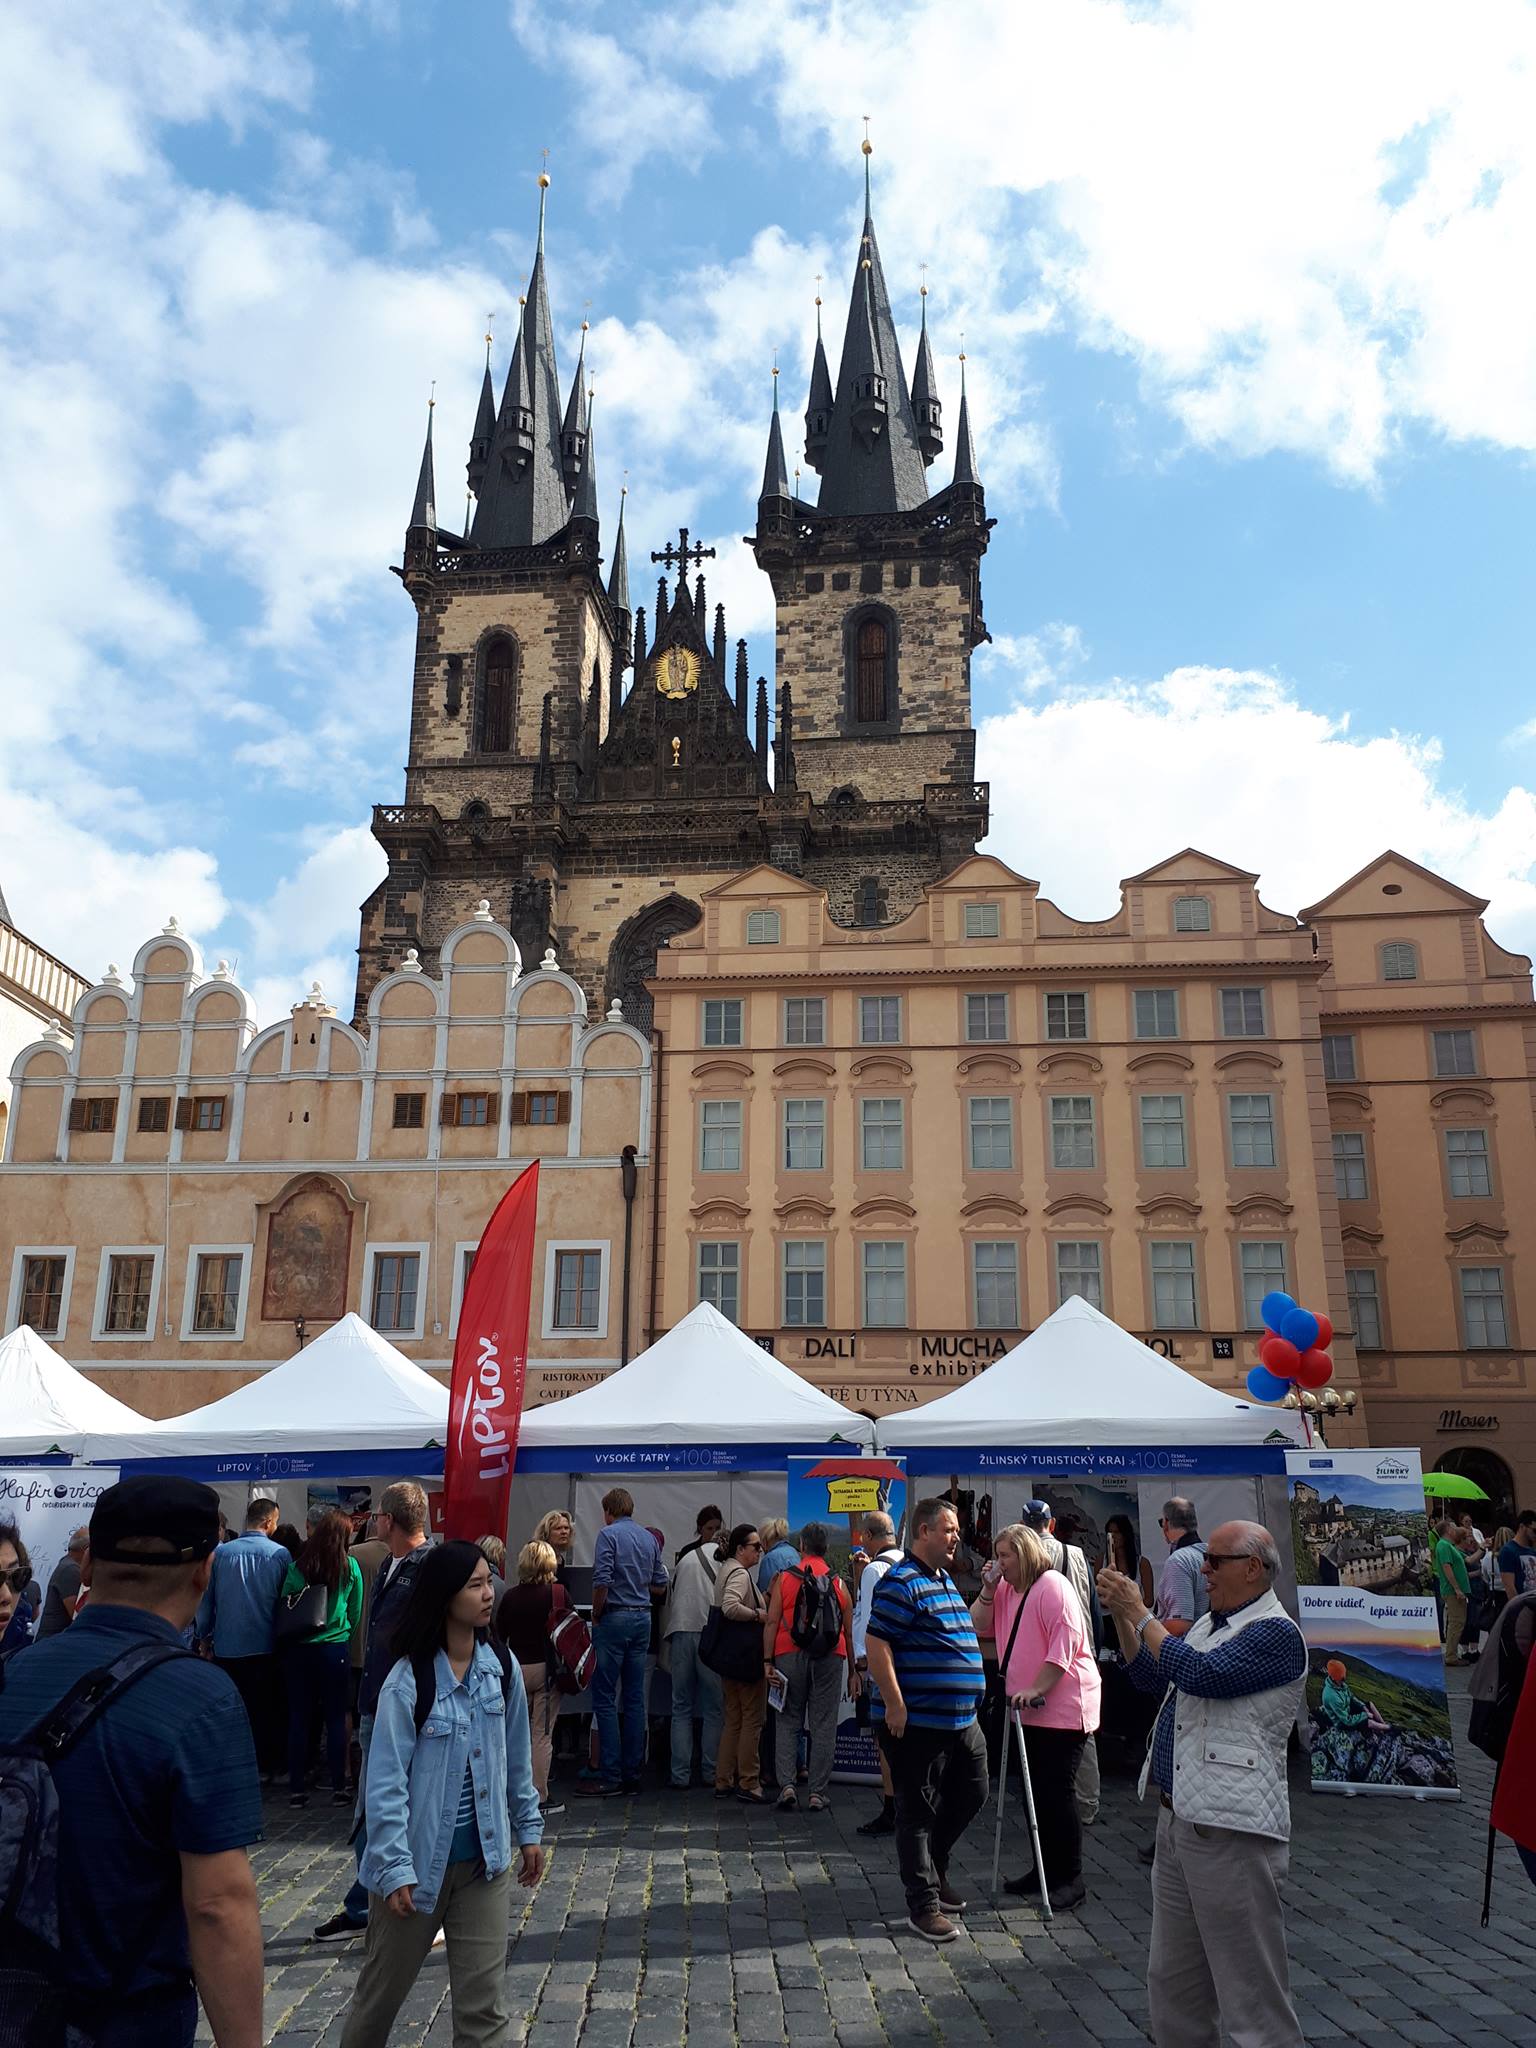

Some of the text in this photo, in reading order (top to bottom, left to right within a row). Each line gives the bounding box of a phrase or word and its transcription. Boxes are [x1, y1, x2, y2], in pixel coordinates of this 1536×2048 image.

[805, 1333, 856, 1357] DALÍ
[921, 1337, 1008, 1357] MUCHA
[909, 1360, 995, 1376] exhibit
[542, 1373, 607, 1382] RISTORANTE
[856, 1388, 867, 1402] U
[871, 1386, 918, 1402] TÝNA
[1437, 1410, 1500, 1432] Moser
[595, 1452, 636, 1463] VYSOKÉ
[640, 1453, 671, 1463] TATRY
[979, 1454, 1028, 1465] ŽILINSKÝ
[1032, 1454, 1095, 1465] TURISTICKÝ
[1099, 1456, 1125, 1466] KRAJ
[217, 1463, 252, 1473] LIPTOV
[1376, 1467, 1410, 1475] ŽILINSKÝ
[1303, 1597, 1365, 1609] Dobre vidieť,
[1370, 1606, 1398, 1619] lepšie
